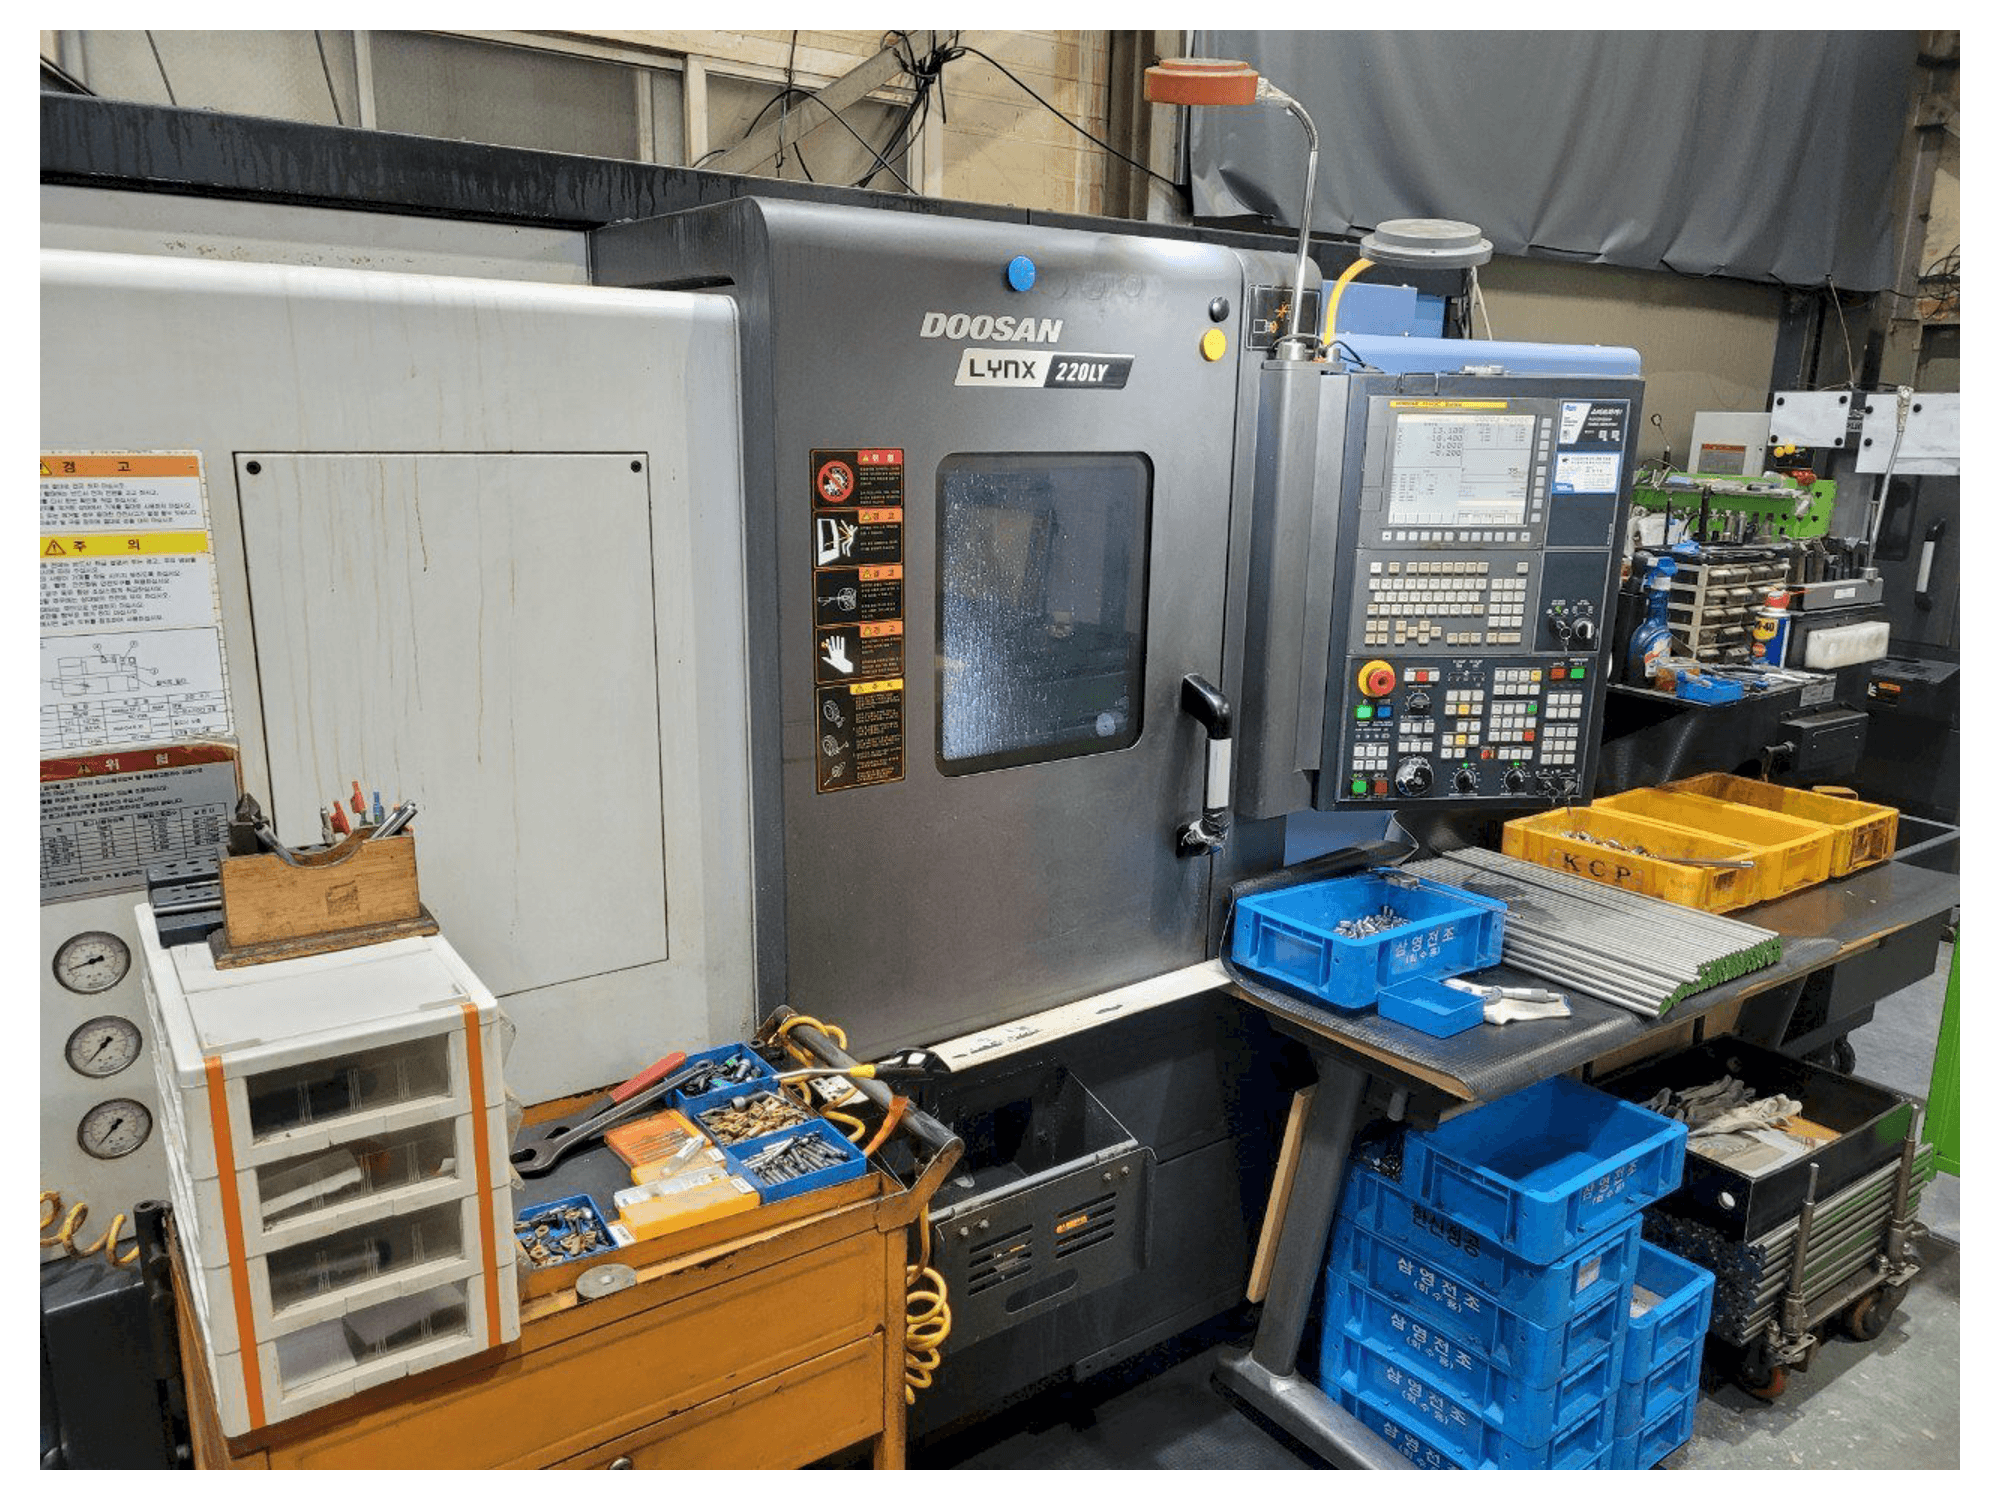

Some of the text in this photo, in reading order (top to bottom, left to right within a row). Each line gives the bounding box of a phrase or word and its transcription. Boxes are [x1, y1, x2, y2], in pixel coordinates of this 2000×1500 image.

[920, 312, 1063, 343] DOOSAN
[1055, 362, 1109, 382] 220LY
[1563, 853, 1631, 882] KCP
[1395, 927, 1454, 958] 삼영전조
[1397, 1257, 1480, 1313] 삼영전조
[1391, 1312, 1472, 1370] 삼영전조
[1386, 1366, 1466, 1425] 삼영전조
